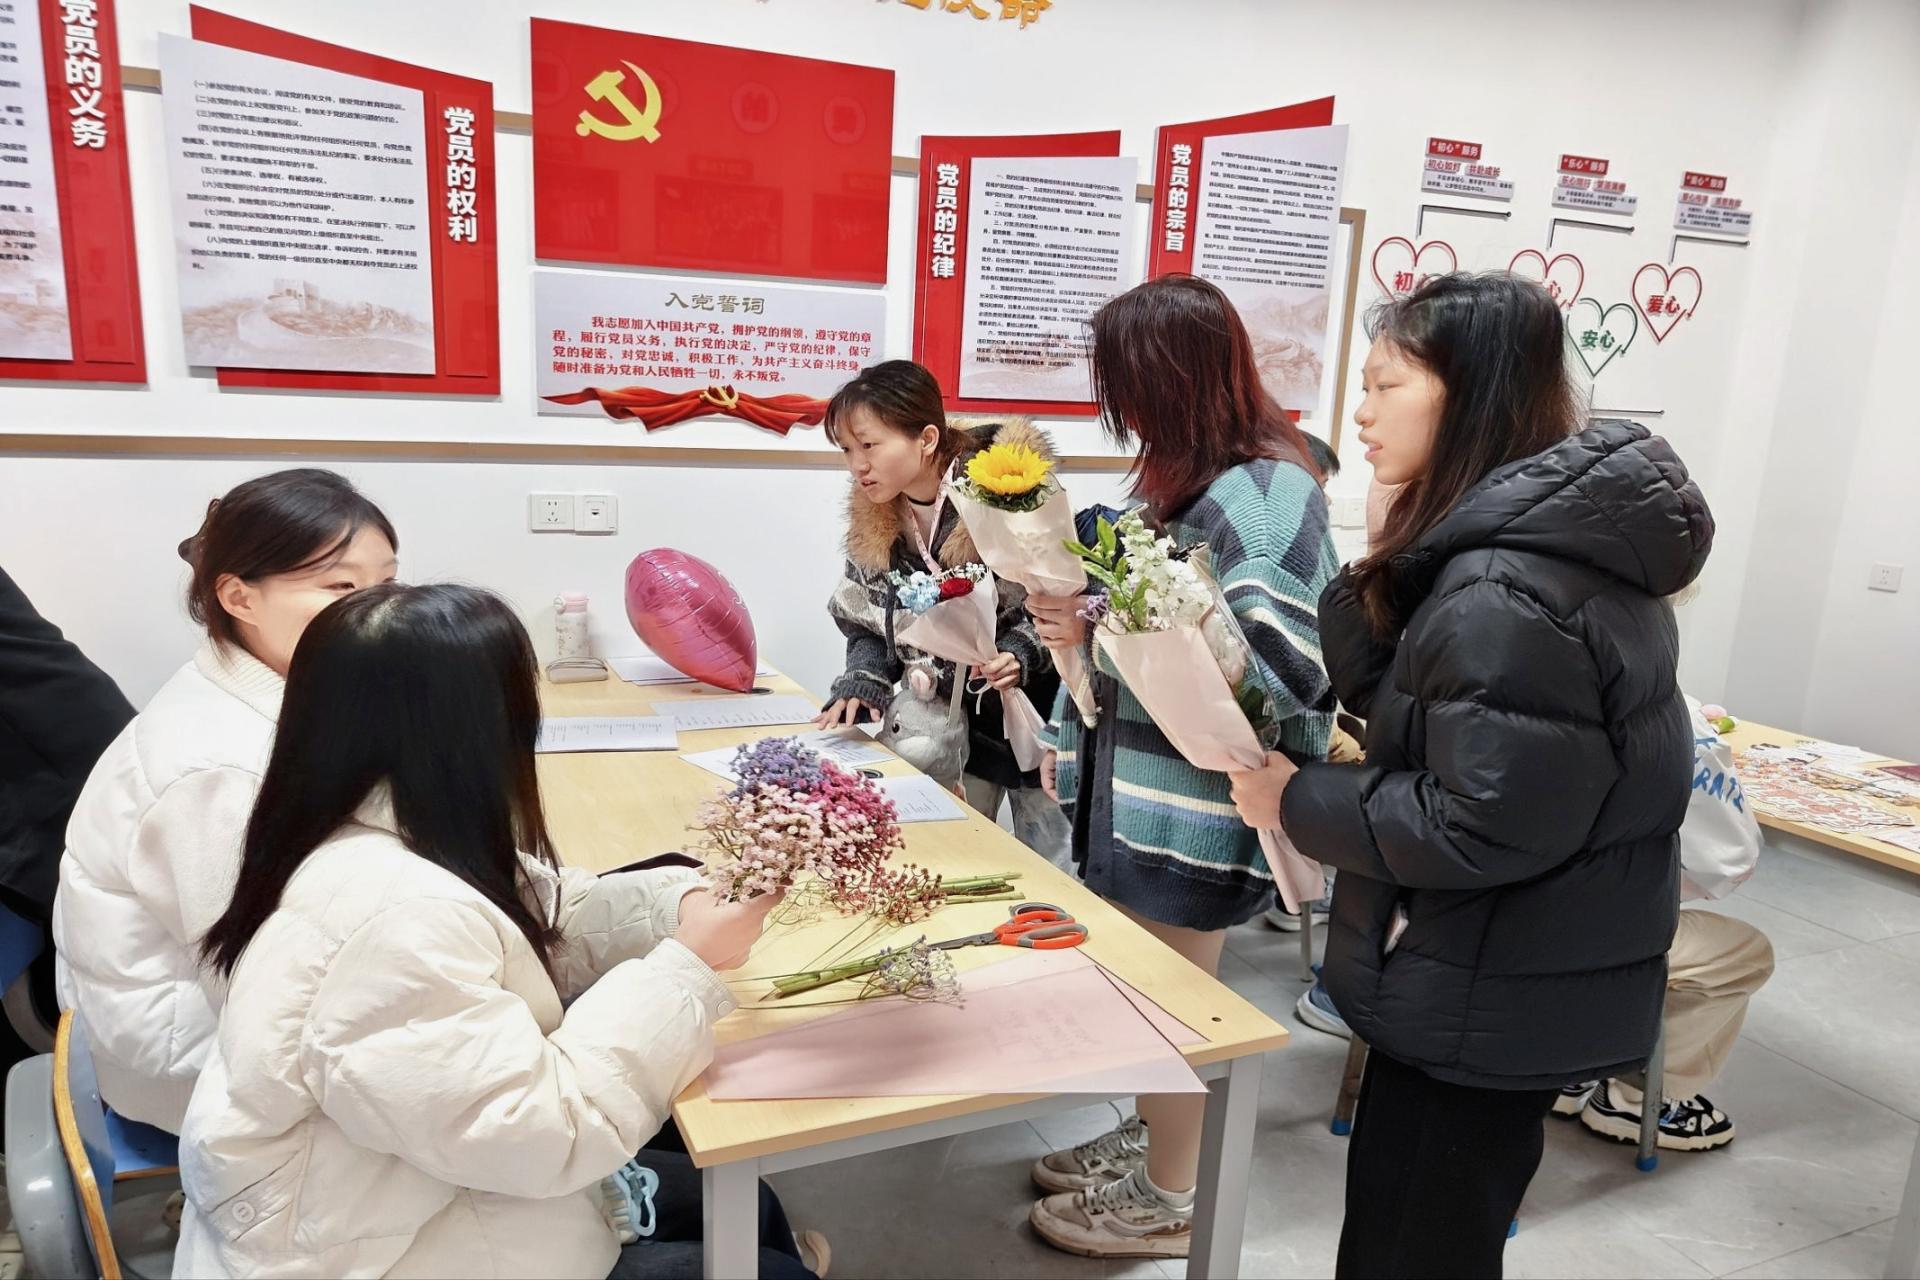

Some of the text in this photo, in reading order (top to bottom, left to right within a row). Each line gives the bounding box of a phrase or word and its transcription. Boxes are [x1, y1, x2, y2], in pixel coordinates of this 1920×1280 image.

[59, 0, 108, 149] 党员的义务
[443, 106, 478, 244] 党员的权利
[930, 162, 960, 279] 党员的纪律
[1164, 142, 1192, 252] 党员的宗旨
[665, 292, 766, 315] 入党誓词
[1580, 330, 1616, 349] 安心
[1646, 294, 1681, 315] 爱心
